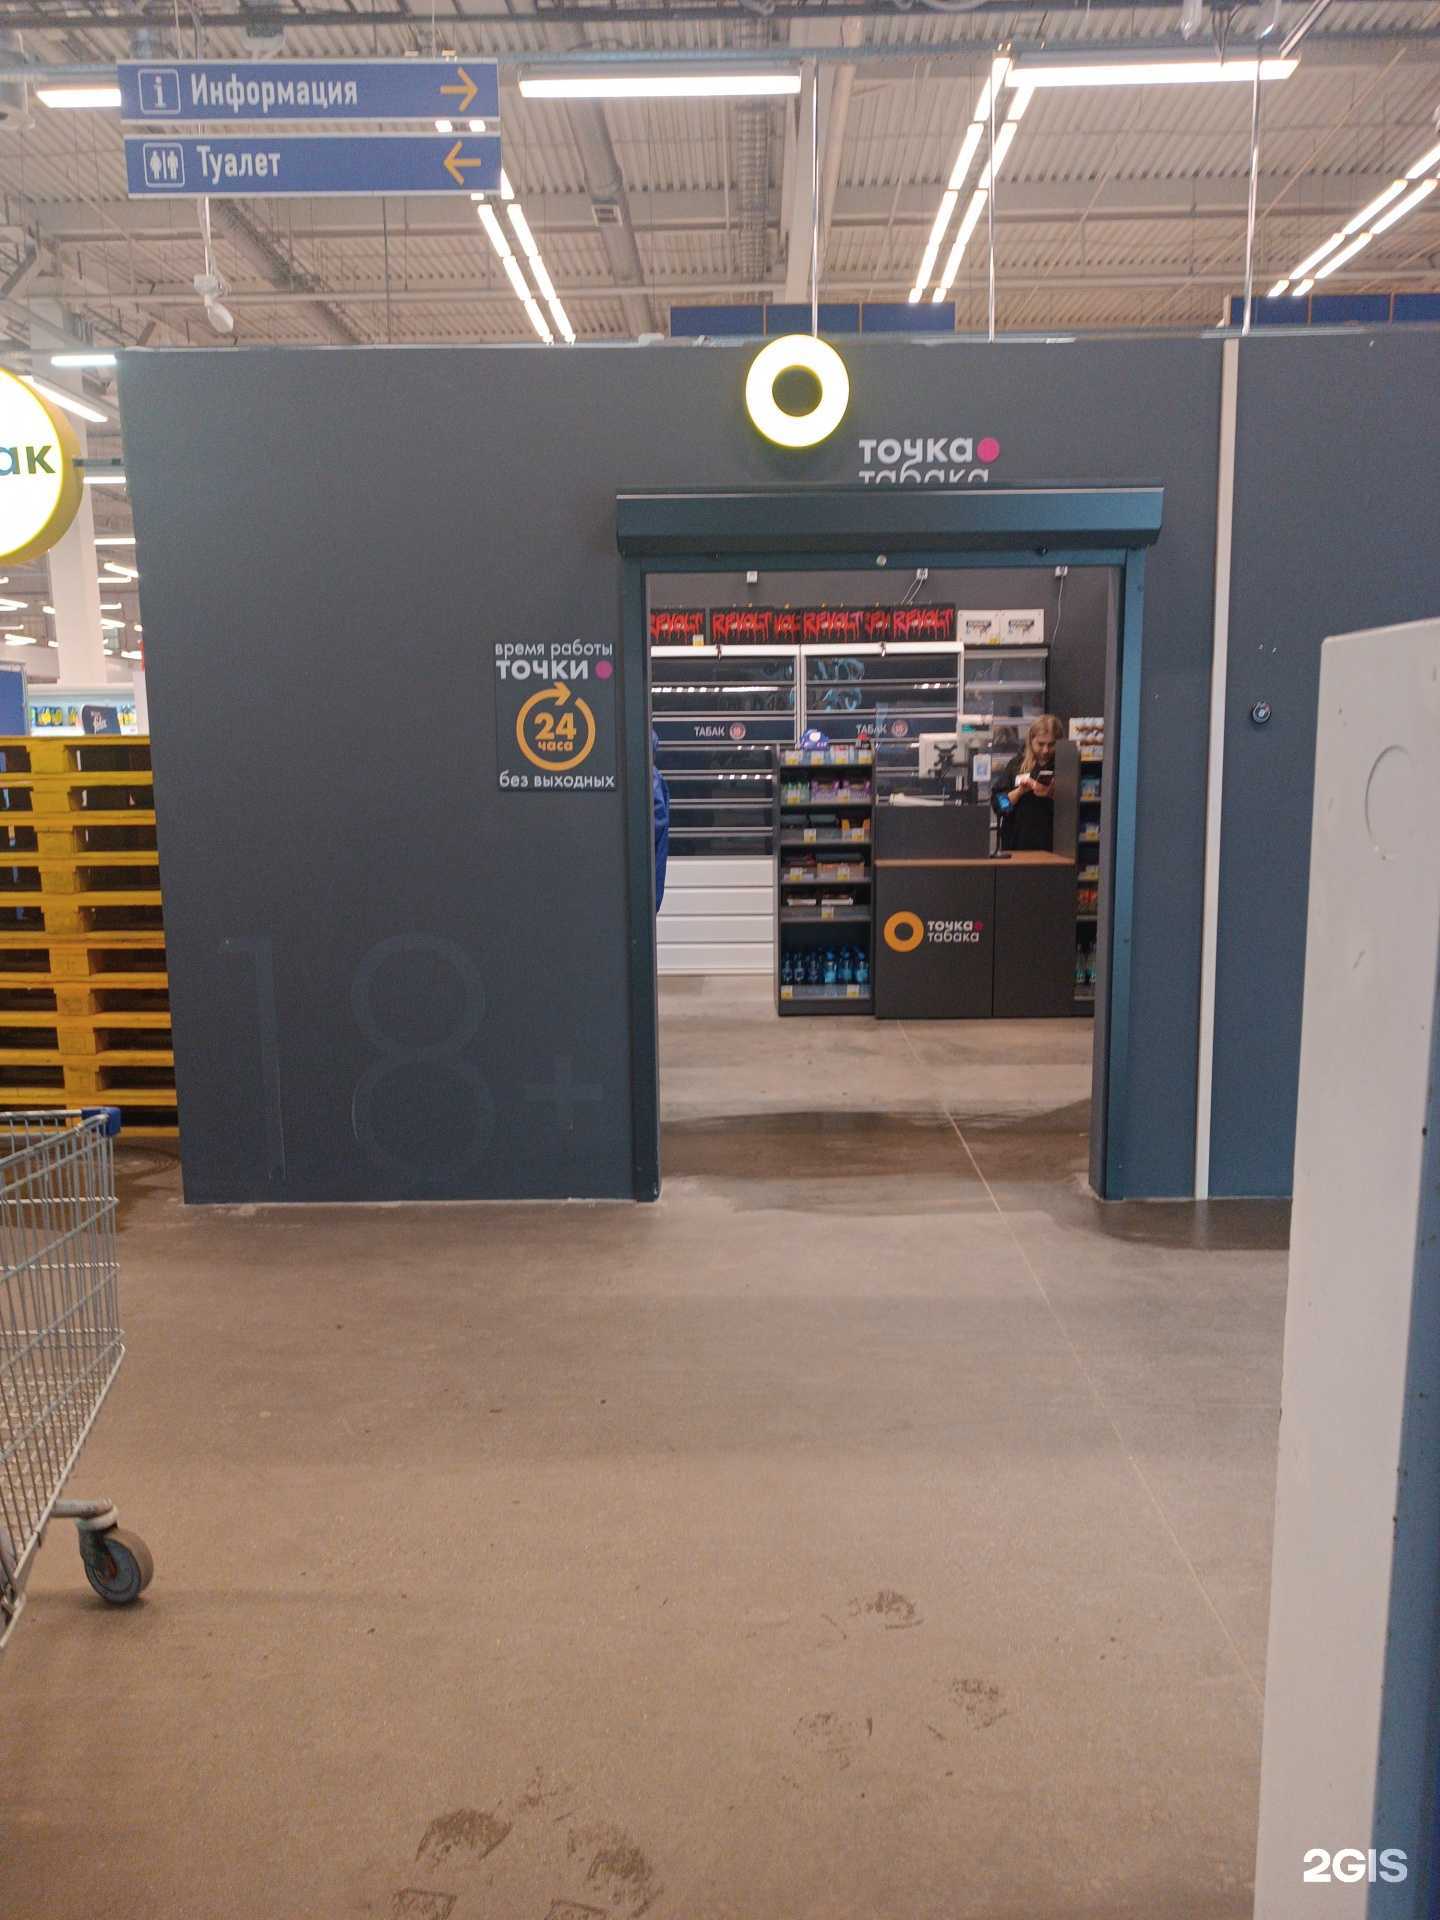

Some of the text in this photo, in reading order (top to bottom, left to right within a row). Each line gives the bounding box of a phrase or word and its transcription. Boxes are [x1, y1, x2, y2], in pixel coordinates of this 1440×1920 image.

[190, 73, 358, 114] Информация
[197, 145, 281, 184] Туалет
[859, 437, 973, 464] точка
[495, 639, 613, 659] время работы
[534, 712, 577, 740] 24
[694, 726, 725, 737] ТАБАК
[537, 740, 574, 752] часа
[499, 770, 615, 788] без выходных
[927, 920, 974, 931] точка
[927, 929, 980, 942] табака
